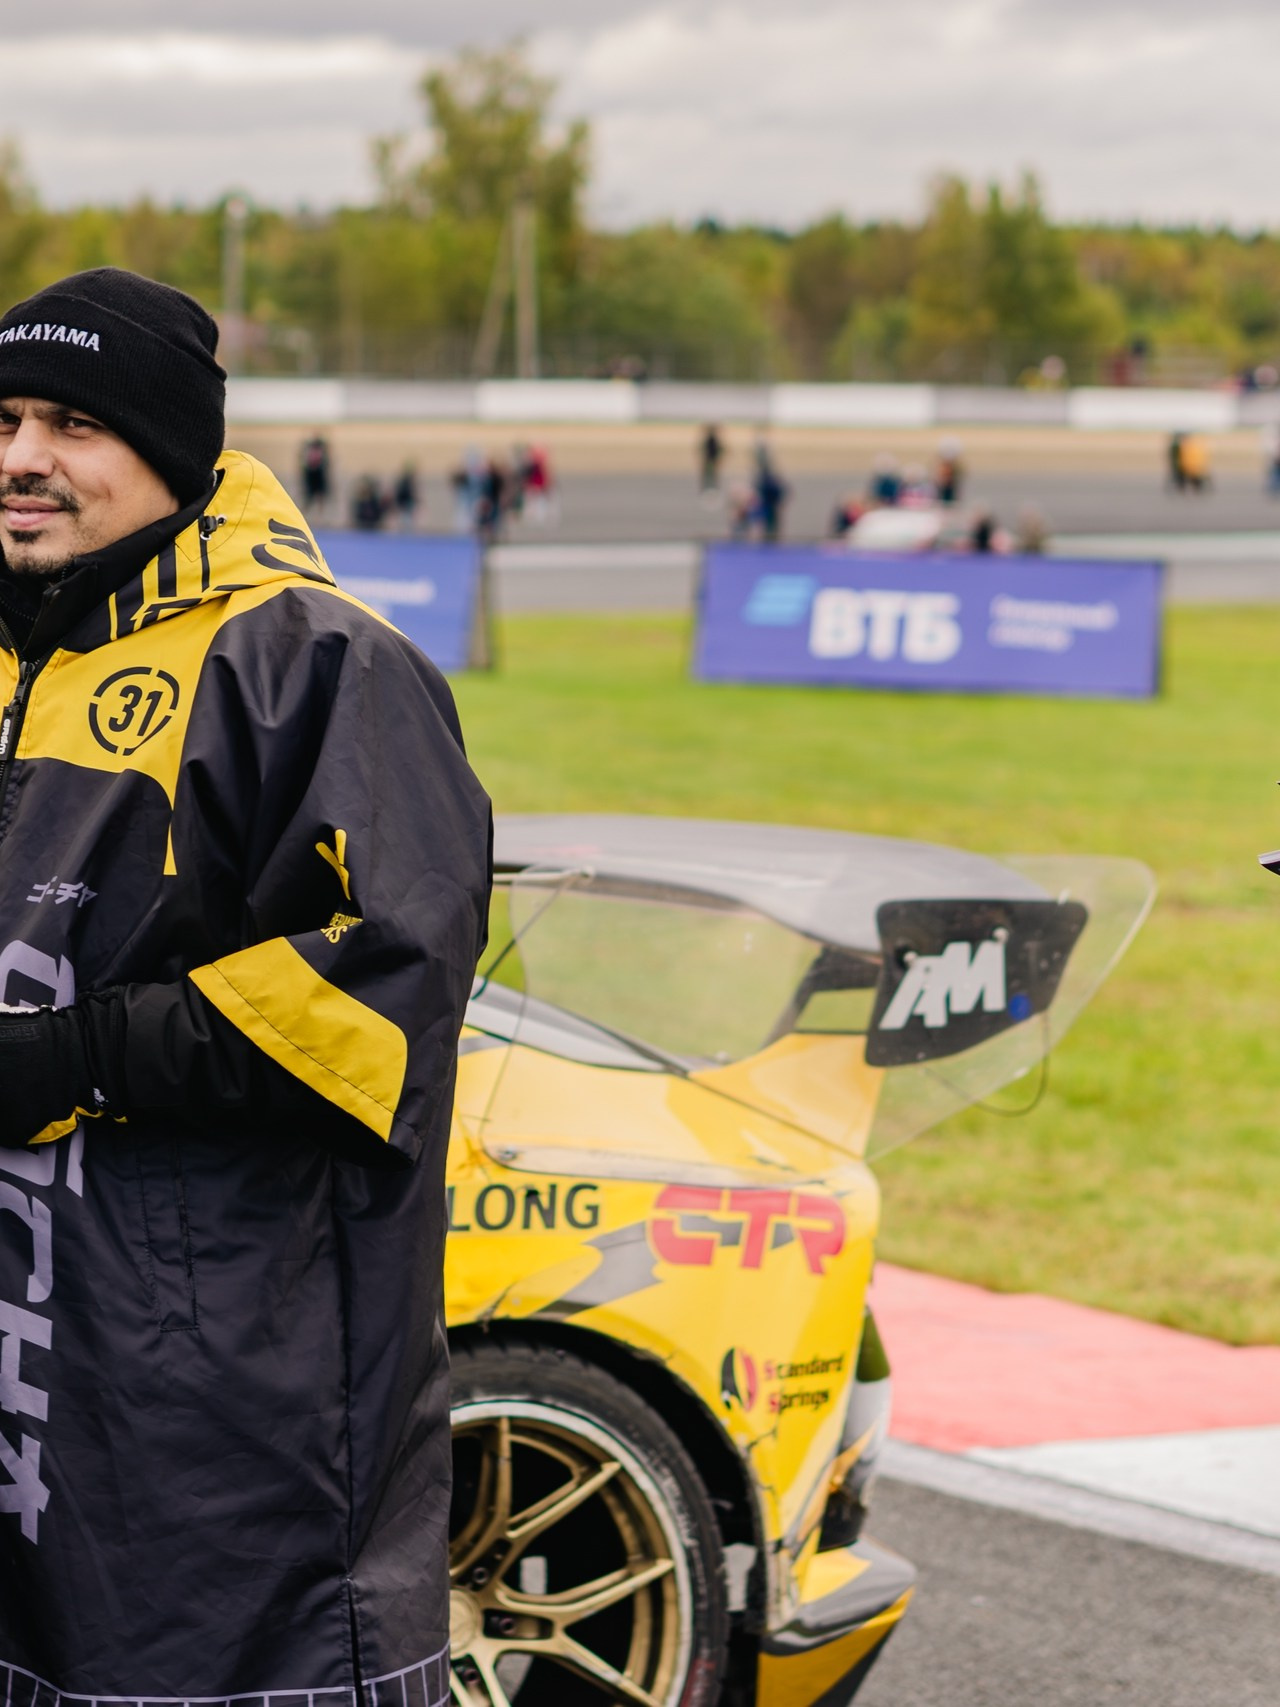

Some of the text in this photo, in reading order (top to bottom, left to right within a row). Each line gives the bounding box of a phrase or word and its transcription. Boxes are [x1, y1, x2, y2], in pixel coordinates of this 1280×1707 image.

[810, 587, 961, 663] ВТБ
[108, 684, 164, 737] 31
[447, 1183, 600, 1232] LONG
